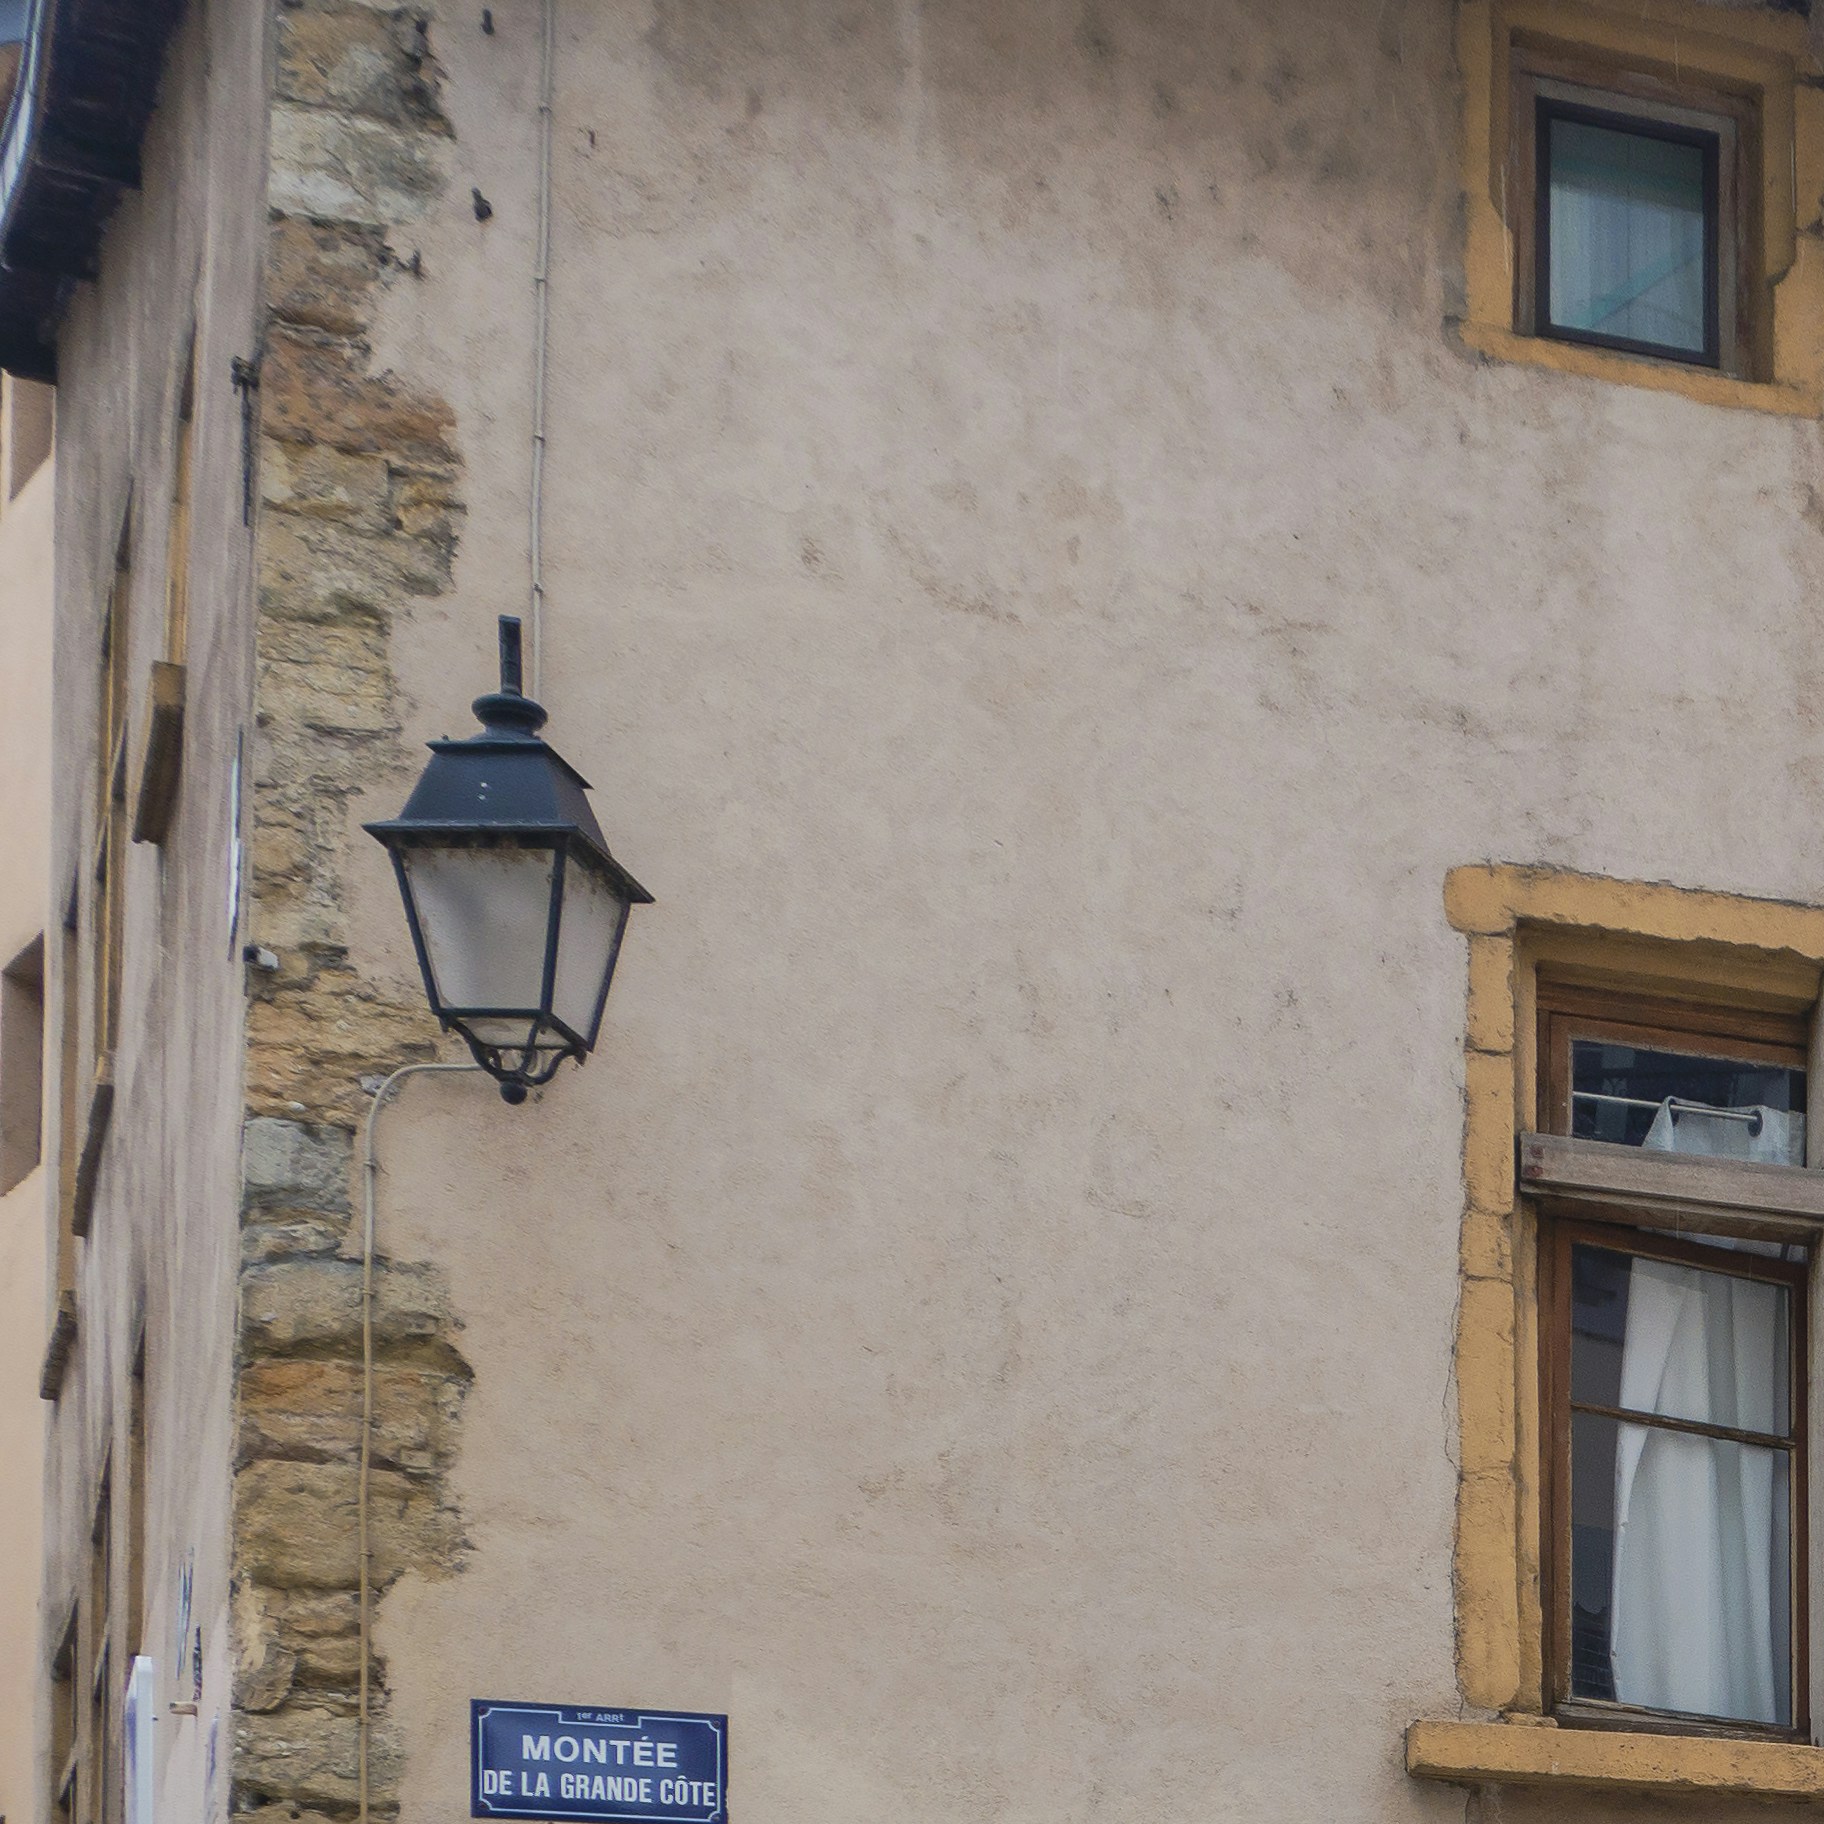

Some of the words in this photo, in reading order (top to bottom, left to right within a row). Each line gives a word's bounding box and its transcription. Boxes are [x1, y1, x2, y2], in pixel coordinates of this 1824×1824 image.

[522, 1734, 679, 1768] MONTÉE
[483, 1769, 513, 1796] DE
[520, 1771, 551, 1798] LA
[560, 1772, 653, 1804] GRANDE
[659, 1775, 717, 1808] CÔTE
